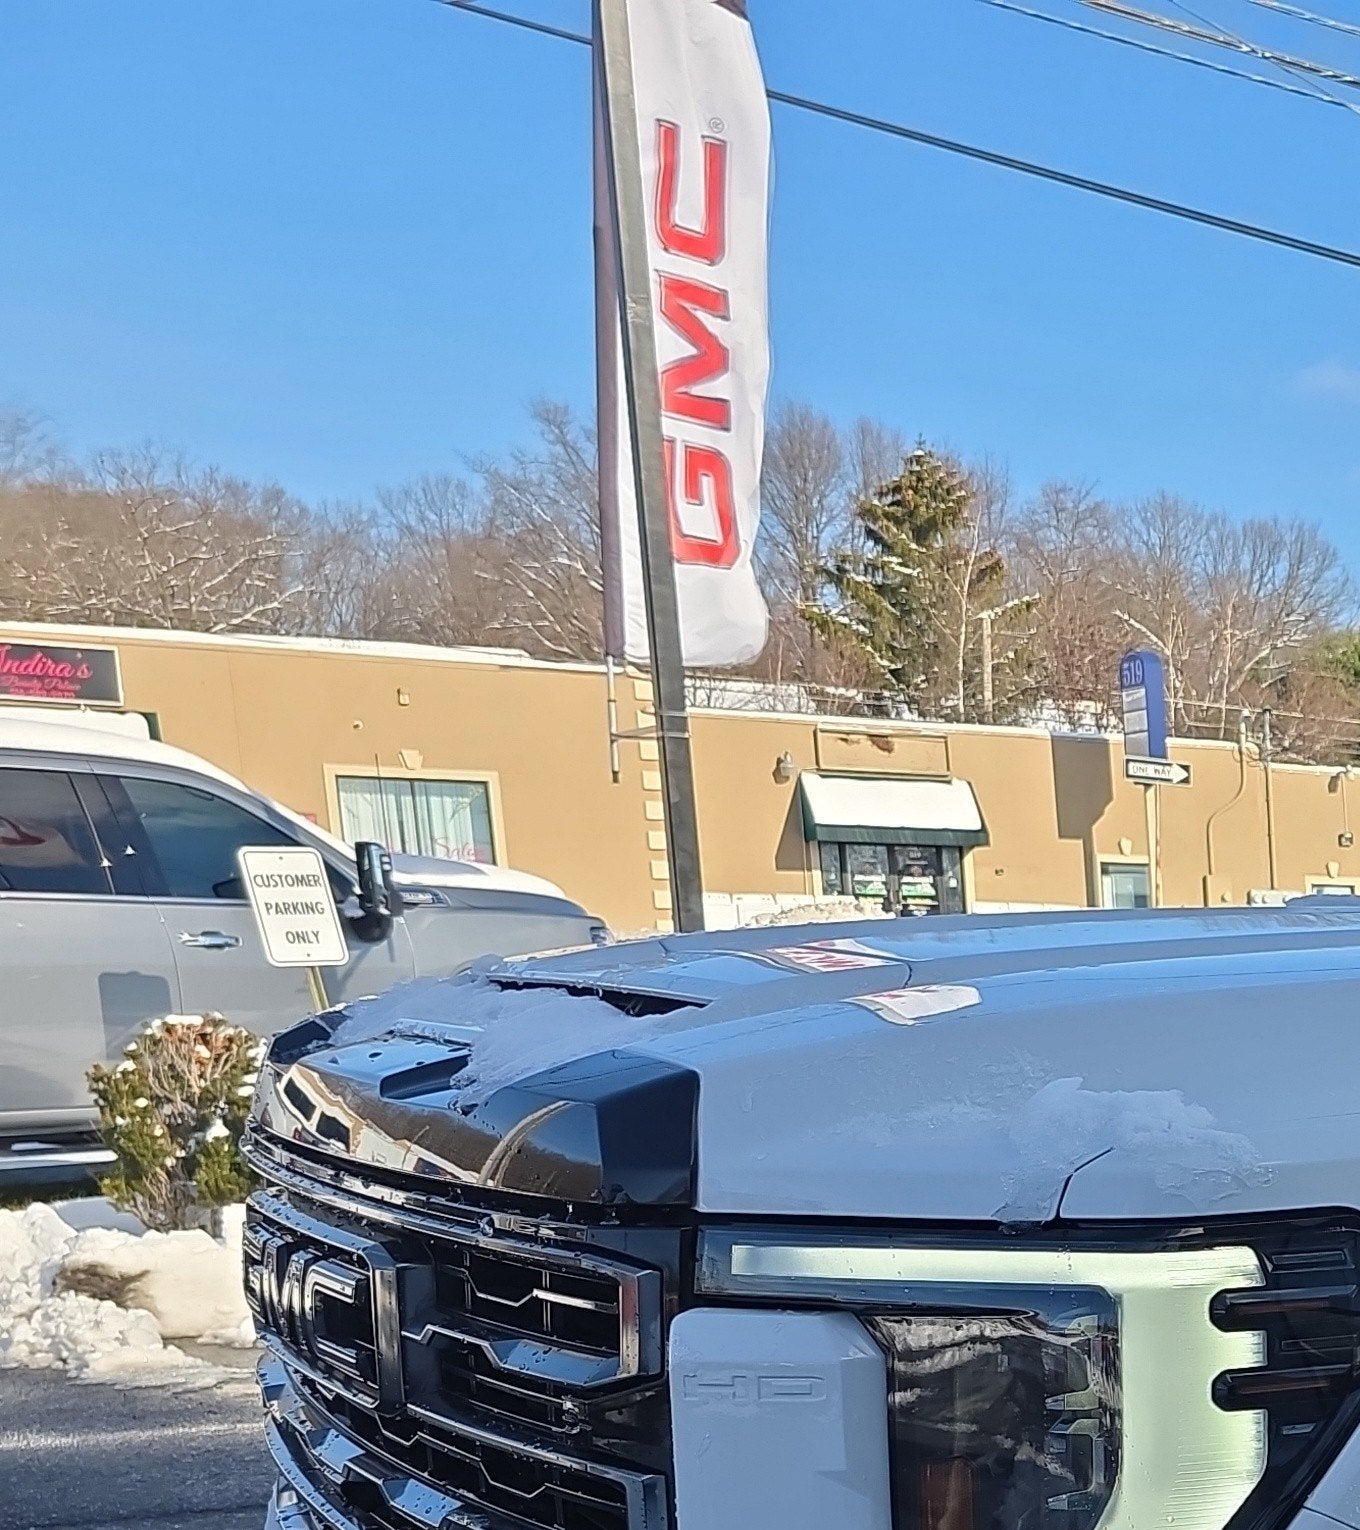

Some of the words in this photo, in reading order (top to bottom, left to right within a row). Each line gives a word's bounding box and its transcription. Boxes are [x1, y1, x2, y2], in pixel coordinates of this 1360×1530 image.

[654, 117, 740, 570] GMC
[1123, 660, 1143, 687] 519
[1132, 764, 1149, 775] ONE
[1154, 765, 1171, 777] WAY
[253, 873, 322, 888] CUSTOMER
[264, 901, 325, 915] PARKING
[285, 930, 321, 944] ONLY
[683, 1374, 827, 1401] HD
